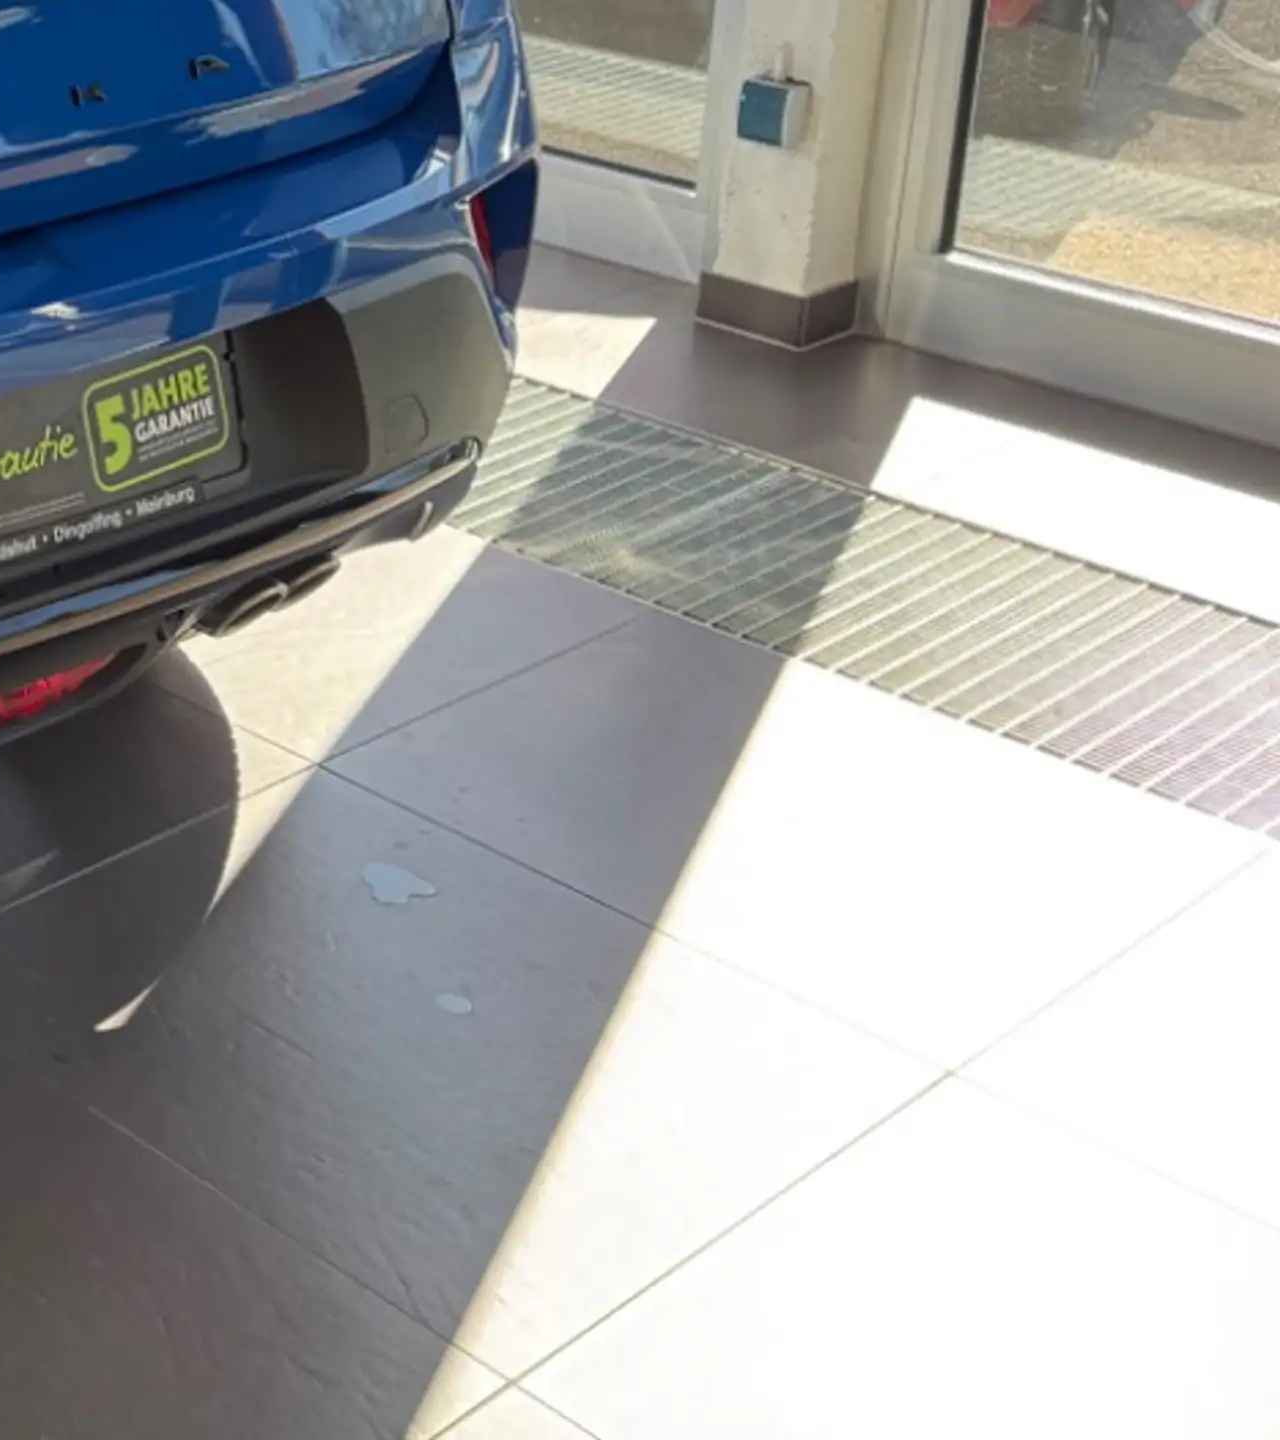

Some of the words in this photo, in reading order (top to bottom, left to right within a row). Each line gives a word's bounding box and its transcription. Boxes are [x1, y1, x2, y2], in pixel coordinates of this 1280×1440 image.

[94, 394, 133, 476] 5
[130, 363, 212, 421] JAHRE
[134, 396, 216, 443] GARANTIE
[53, 510, 123, 544] Dingolfing
[136, 485, 196, 517] Mainburg
